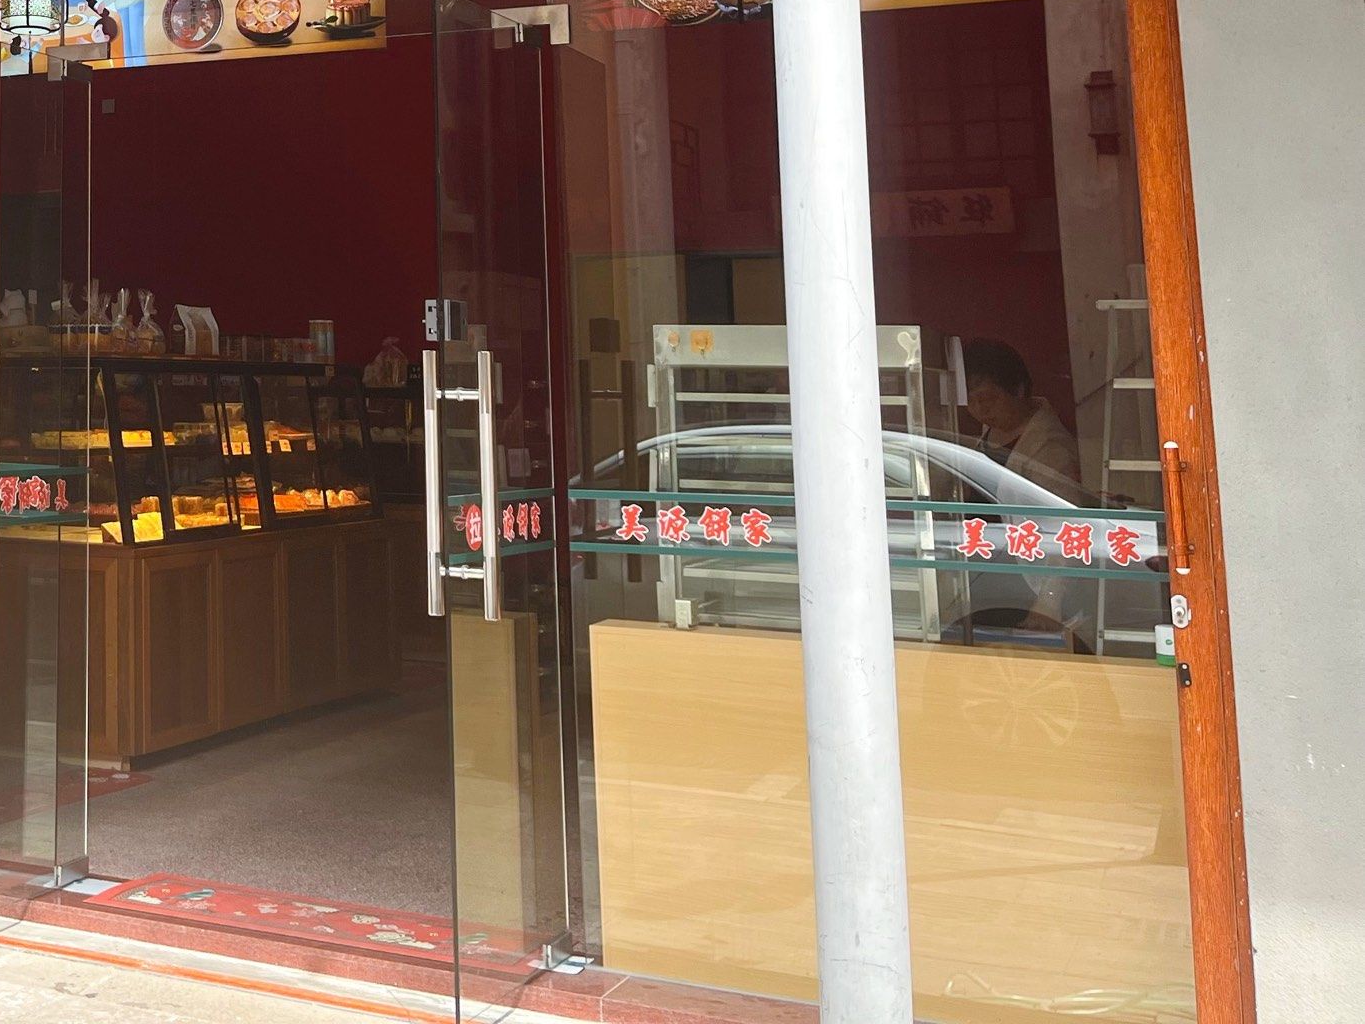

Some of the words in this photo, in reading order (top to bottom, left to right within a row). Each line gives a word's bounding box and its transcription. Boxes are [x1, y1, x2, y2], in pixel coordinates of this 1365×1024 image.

[616, 503, 773, 548] 美源餅家
[956, 517, 1142, 567] 美源餅家
